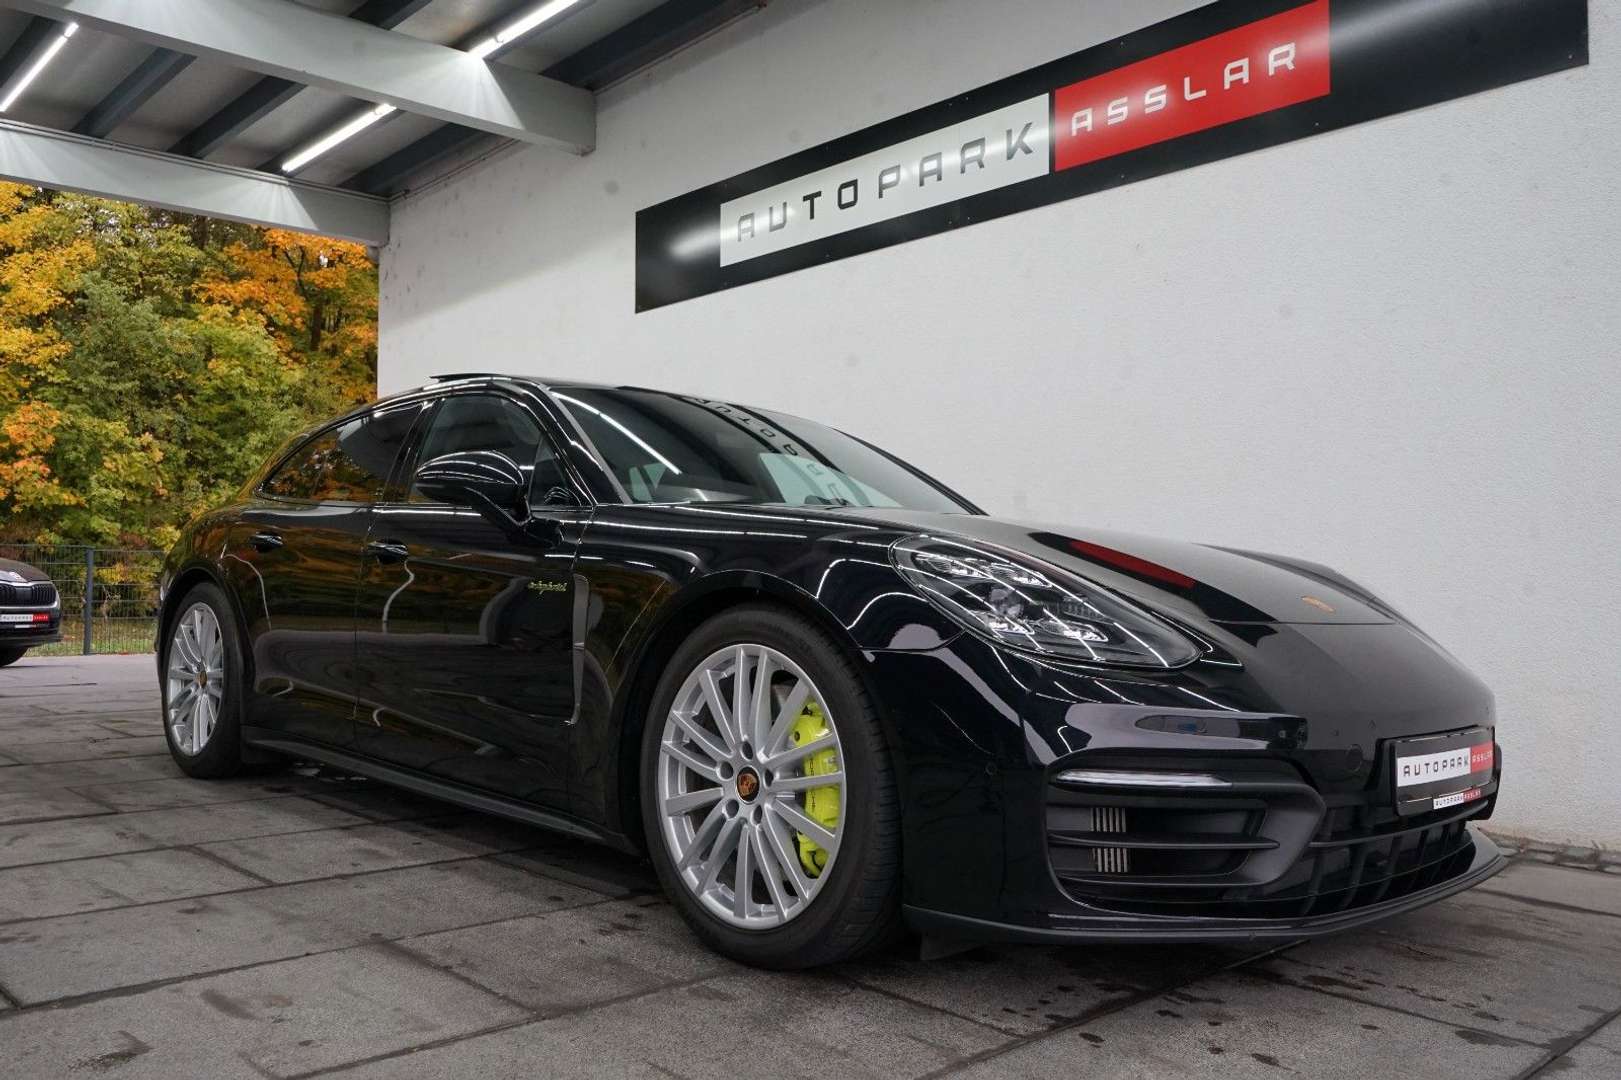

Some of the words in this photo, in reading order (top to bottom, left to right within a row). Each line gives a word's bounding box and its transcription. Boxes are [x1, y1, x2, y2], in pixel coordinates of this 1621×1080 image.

[737, 121, 1034, 242] AUTOPARK
[1071, 42, 1296, 137] ASSLAR
[1402, 756, 1469, 777] AUTOPARK
